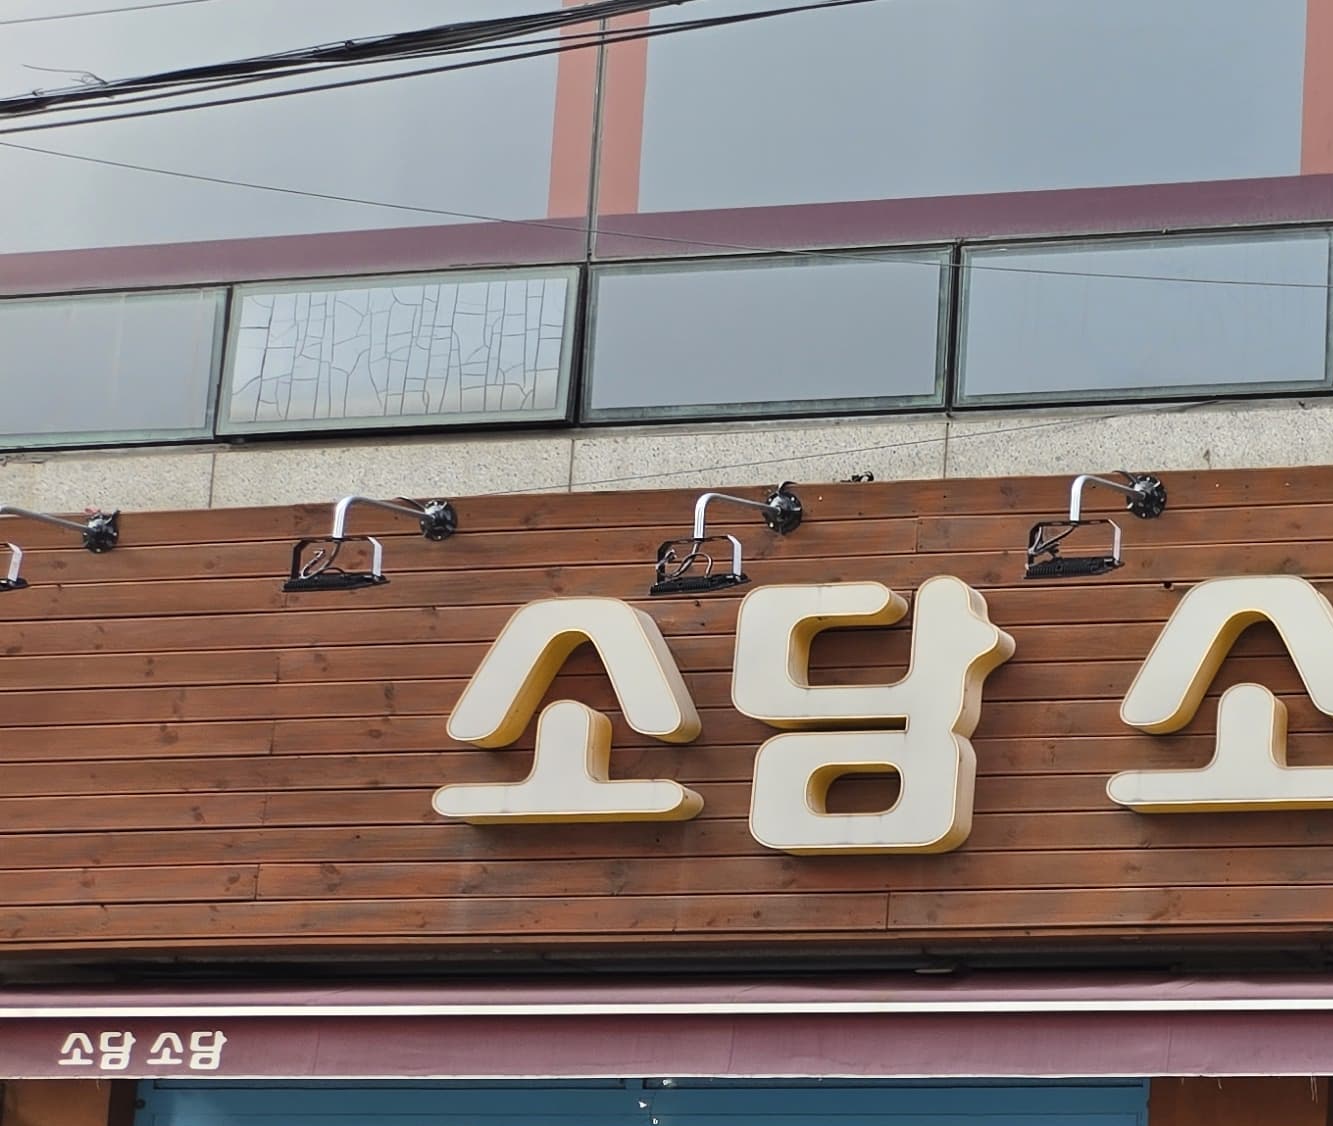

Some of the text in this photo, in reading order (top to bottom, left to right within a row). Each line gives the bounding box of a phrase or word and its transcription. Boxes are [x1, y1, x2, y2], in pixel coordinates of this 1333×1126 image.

[432, 575, 1016, 856] 소담
[58, 1031, 227, 1070] 소담 소담
